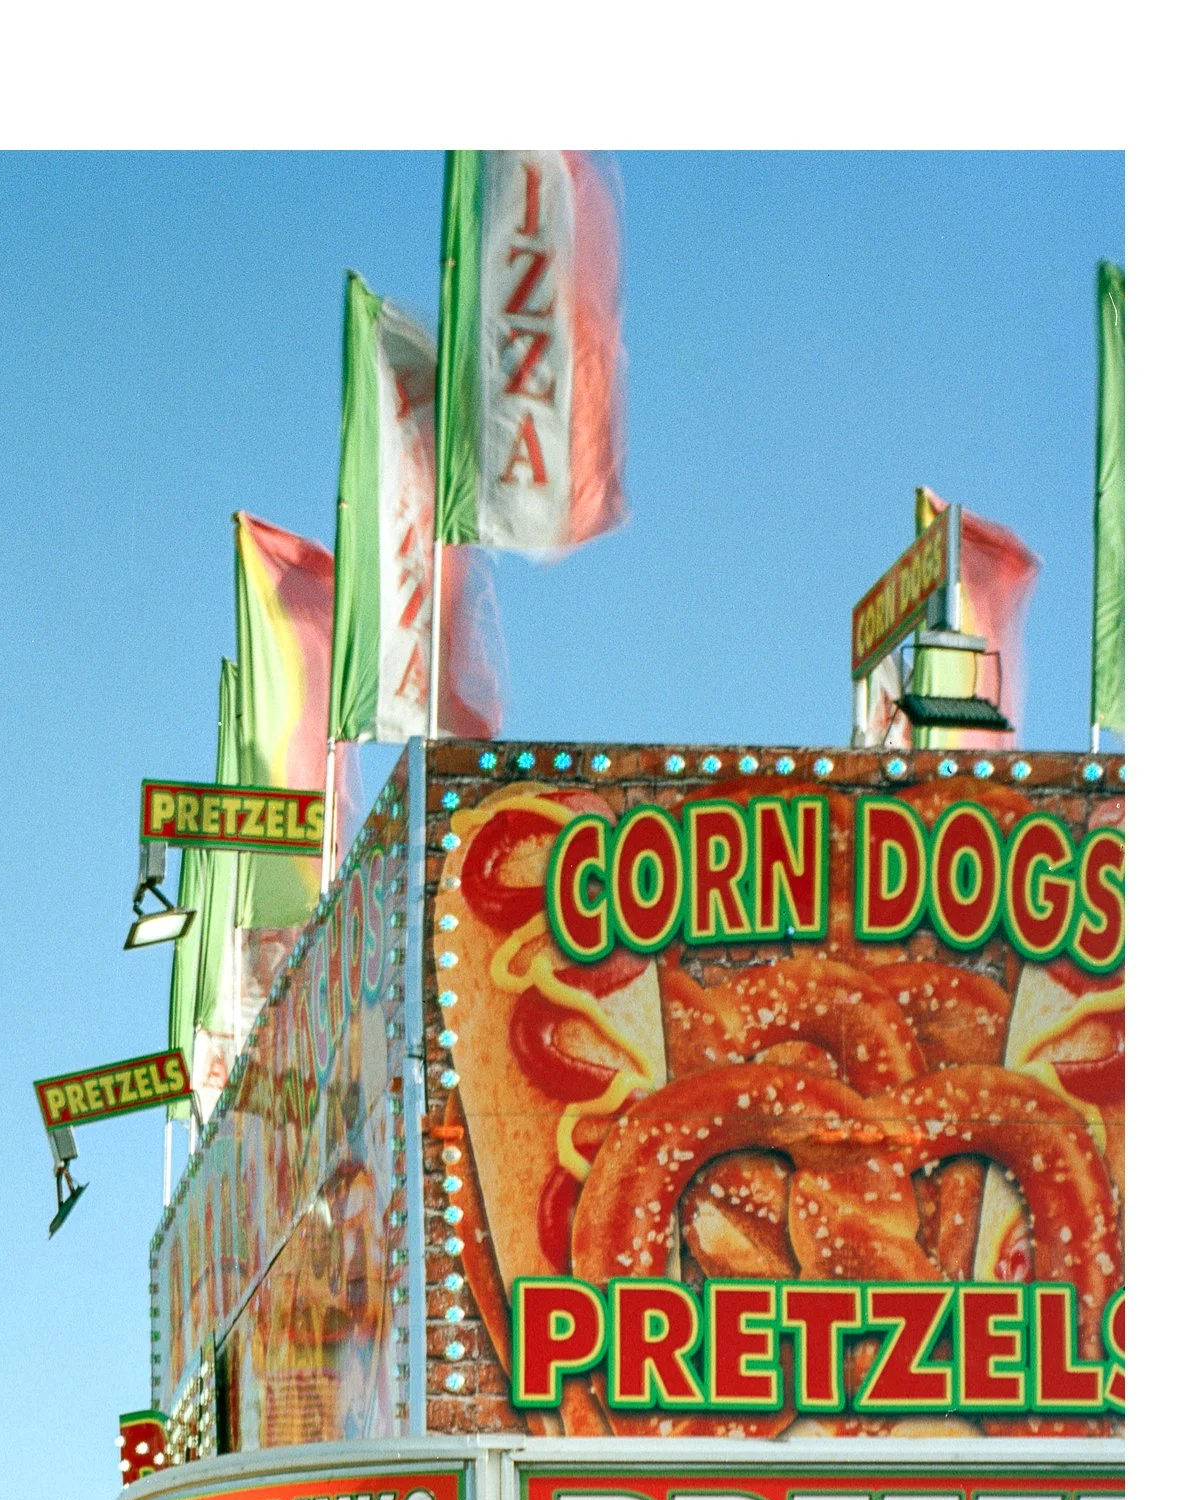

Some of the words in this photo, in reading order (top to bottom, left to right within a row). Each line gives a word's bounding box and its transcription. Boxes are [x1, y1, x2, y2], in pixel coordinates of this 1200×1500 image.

[499, 159, 556, 487] IZZA
[150, 792, 324, 842] PRETZELS
[548, 795, 828, 960] CORN
[856, 795, 1125, 973] DOGS
[43, 1057, 187, 1121] PRETZELS
[513, 1276, 1125, 1412] PRETZEL
